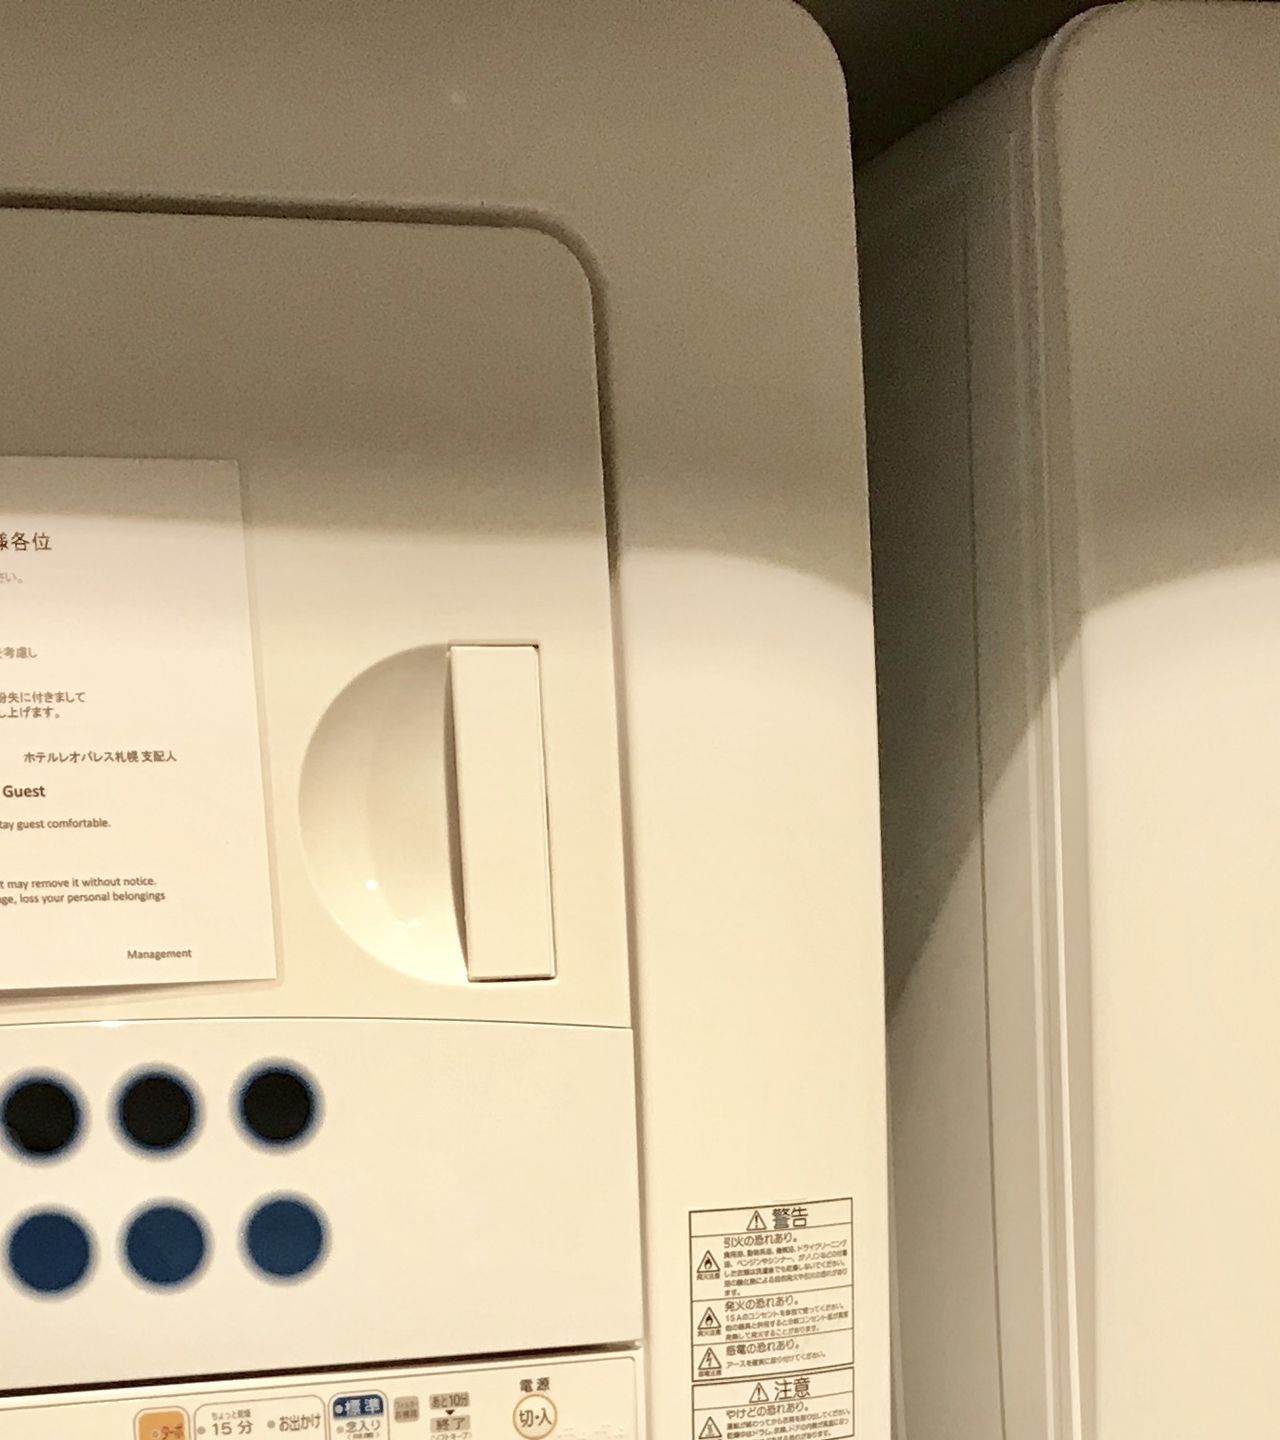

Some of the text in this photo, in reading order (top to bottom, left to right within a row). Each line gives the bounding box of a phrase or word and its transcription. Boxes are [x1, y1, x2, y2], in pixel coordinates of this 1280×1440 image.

[1, 784, 47, 799] Guest
[16, 819, 46, 832] guest
[46, 817, 112, 829] comfortable.
[6, 880, 29, 891] may
[30, 879, 70, 889] remove
[71, 877, 80, 888] it
[81, 876, 122, 888] without
[122, 876, 157, 887] notice.
[19, 893, 40, 904] loss
[41, 894, 65, 905] your
[66, 891, 111, 905] personal
[111, 890, 166, 903] belongings
[126, 948, 193, 962] Management
[772, 1206, 809, 1230] 警告
[723, 1231, 798, 1249] 引火の恐れあり。
[724, 1294, 799, 1313] 発火の恐れあり。
[725, 1339, 800, 1356] 感電の恐れあり。
[519, 1377, 551, 1393] 電源
[774, 1377, 811, 1401] 注意
[725, 1400, 809, 1419] やけどの恐れあり。
[278, 1414, 322, 1432] お出かけ
